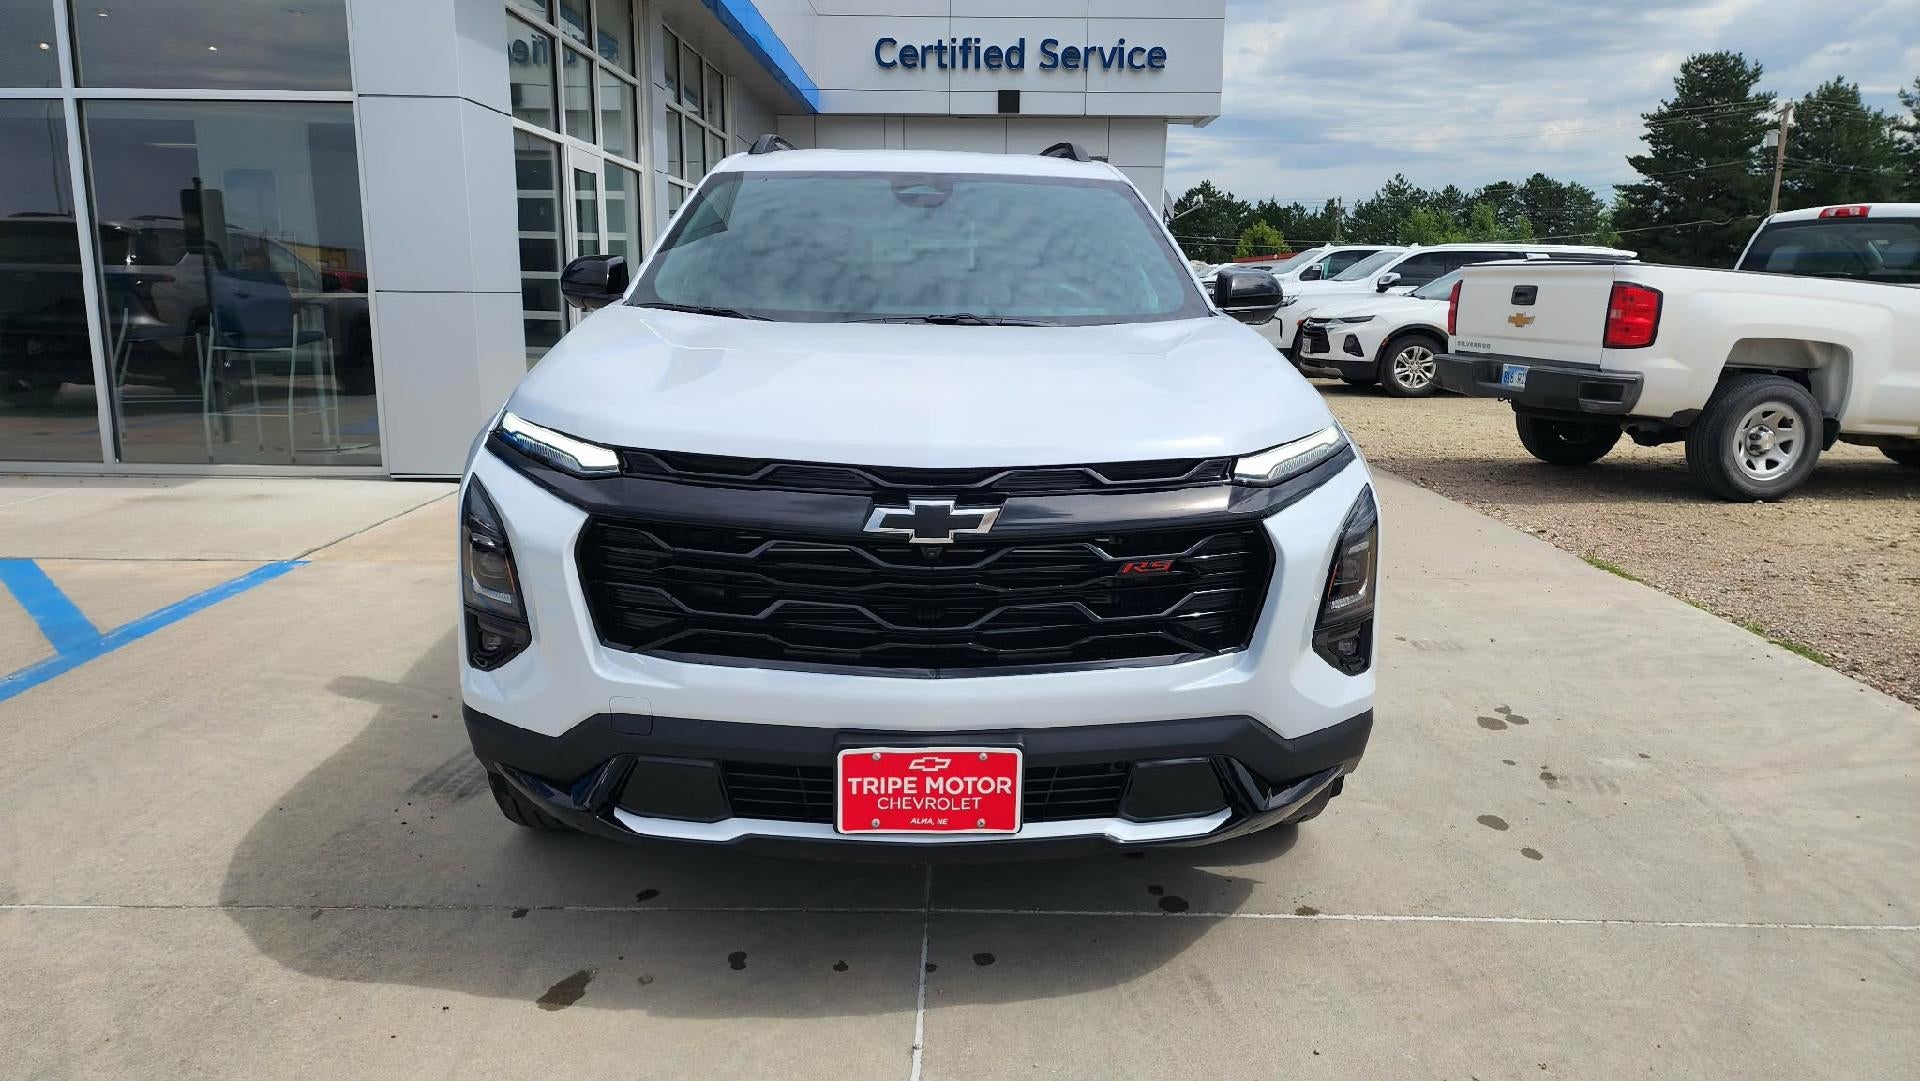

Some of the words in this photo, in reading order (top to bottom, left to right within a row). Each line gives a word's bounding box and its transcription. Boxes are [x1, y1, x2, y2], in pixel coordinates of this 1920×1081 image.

[874, 37, 1026, 70] Certified
[1039, 38, 1168, 71] Service
[1121, 560, 1172, 575] RS
[848, 776, 918, 795] TRIPE
[925, 776, 1012, 795] MOTOR
[877, 797, 982, 811] CHEVROLET
